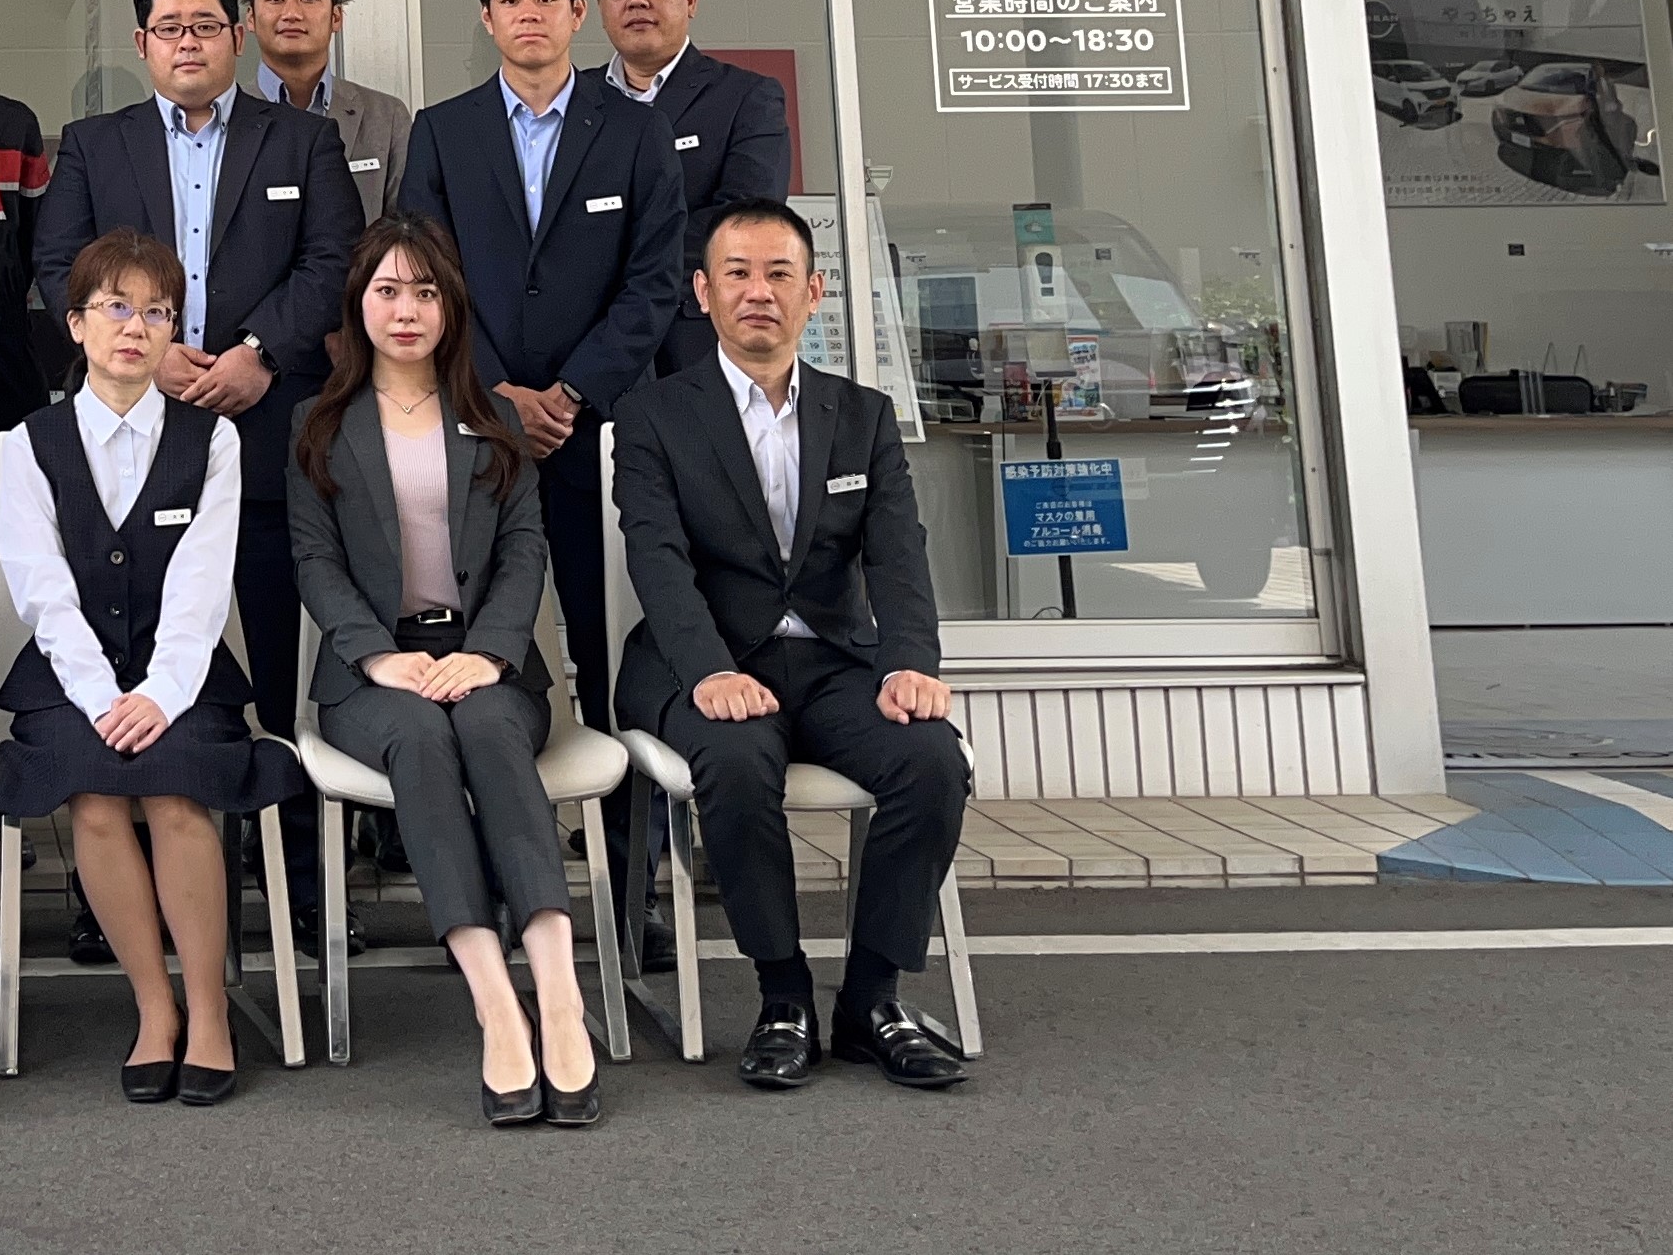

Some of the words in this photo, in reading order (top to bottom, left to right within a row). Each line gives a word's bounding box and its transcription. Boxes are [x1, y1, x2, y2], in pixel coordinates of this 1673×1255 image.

[1442, 5, 1537, 24] やっちゃえ
[957, 73, 1079, 90] サービス受付時間
[1083, 73, 1164, 89] 17:30まで
[807, 217, 835, 229] レン
[828, 314, 835, 322] 6
[806, 328, 817, 336] 12
[829, 328, 839, 336] 13
[830, 342, 842, 350] 20
[833, 356, 844, 364] 27
